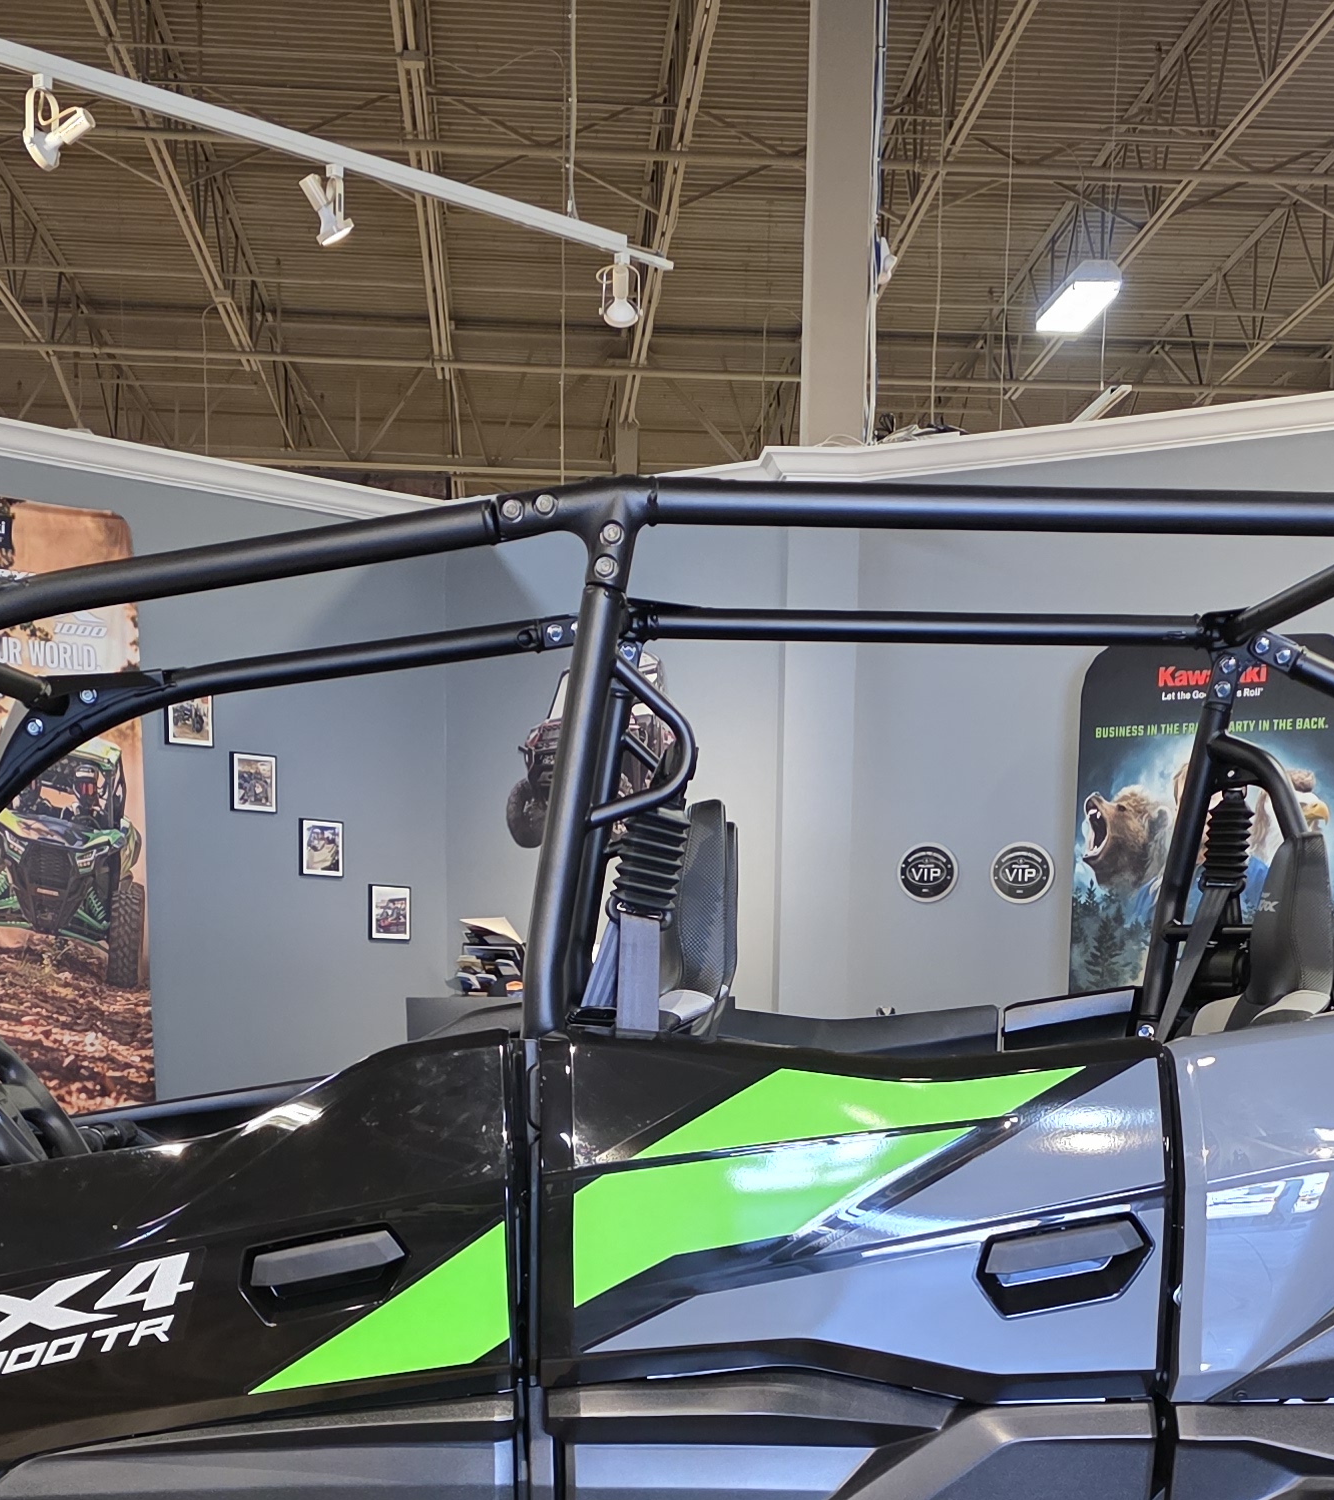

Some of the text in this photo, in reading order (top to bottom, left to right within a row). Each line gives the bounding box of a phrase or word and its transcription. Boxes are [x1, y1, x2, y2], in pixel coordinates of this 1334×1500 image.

[54, 622, 108, 638] 1000
[28, 641, 102, 671] WORLD.
[1161, 691, 1176, 701] Let
[1177, 691, 1191, 700] the
[1095, 725, 1144, 738] BUSINESS
[1147, 724, 1157, 736] IN
[1160, 723, 1179, 735] THE
[1228, 717, 1329, 733] ARTY IN THE BACK.
[911, 868, 941, 881] VIP
[1005, 868, 1036, 882] VIP
